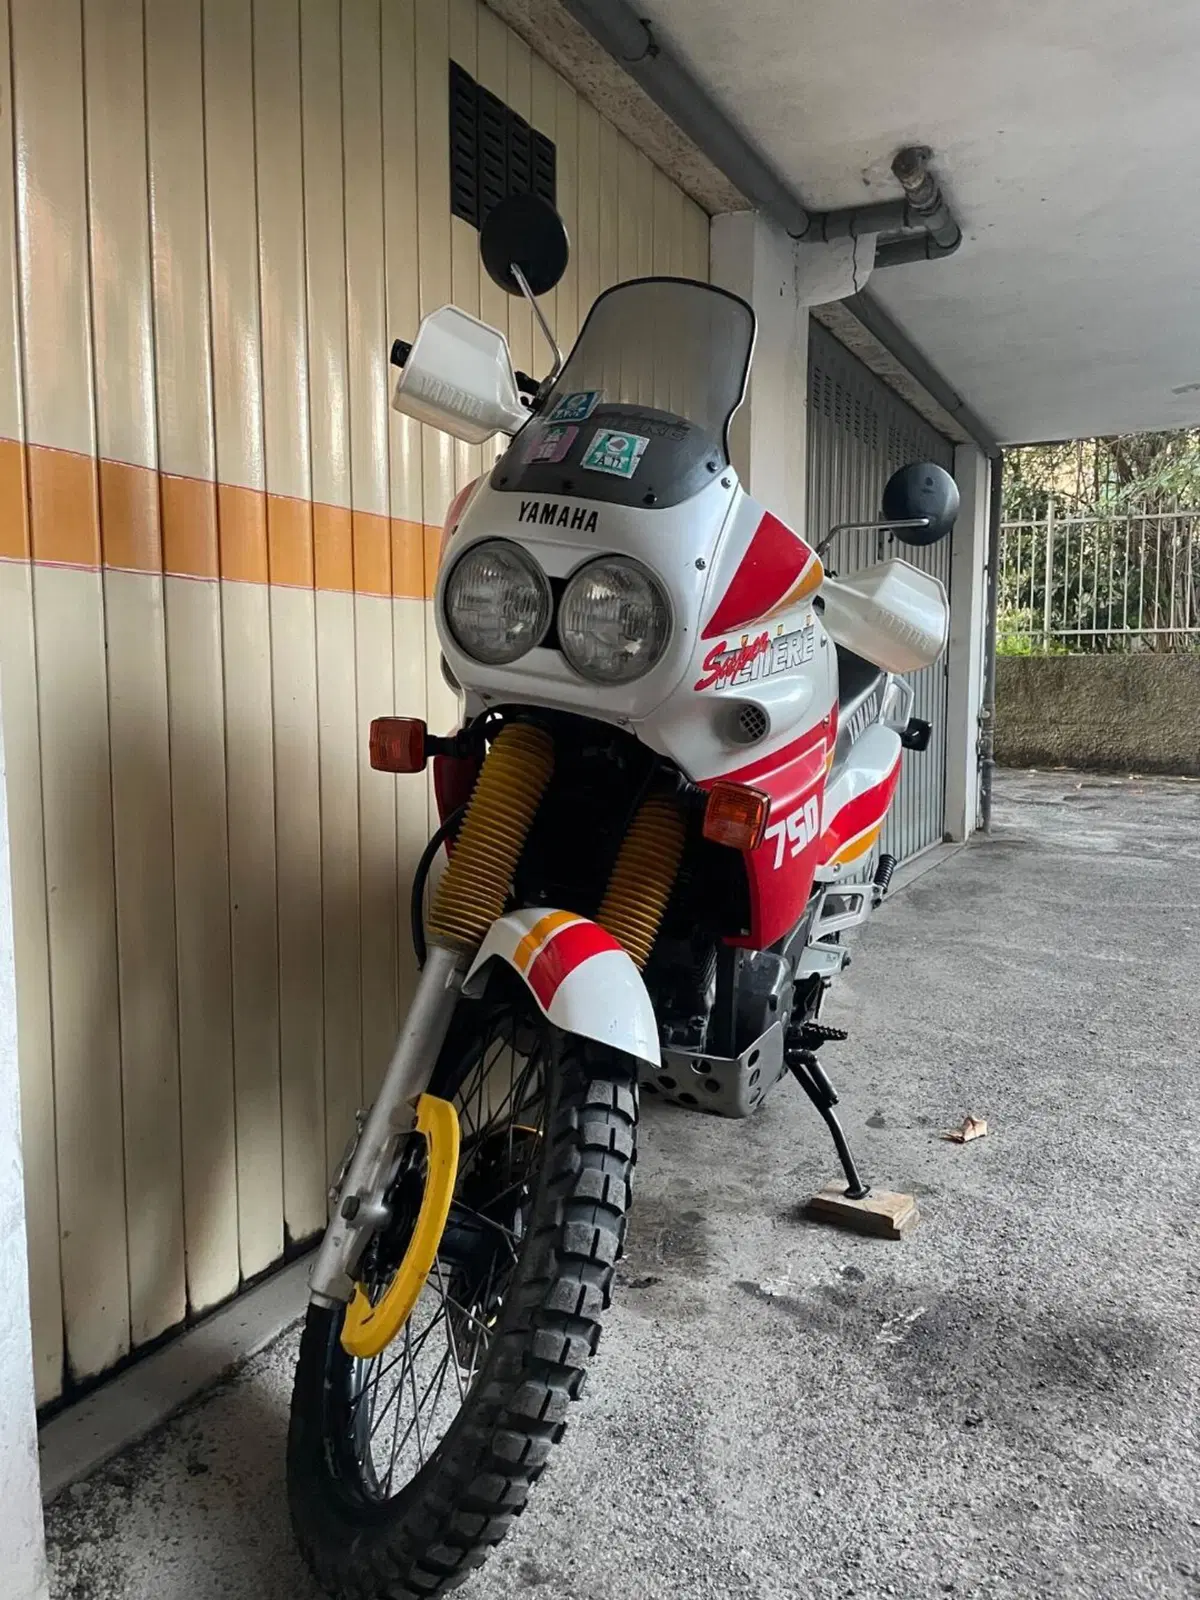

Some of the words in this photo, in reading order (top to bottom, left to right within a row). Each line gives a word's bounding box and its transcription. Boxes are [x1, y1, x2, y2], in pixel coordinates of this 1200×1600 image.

[518, 501, 599, 533] YAMAHA
[694, 631, 768, 691] Super
[846, 692, 878, 744] YAMAHA
[764, 794, 819, 870] 750
